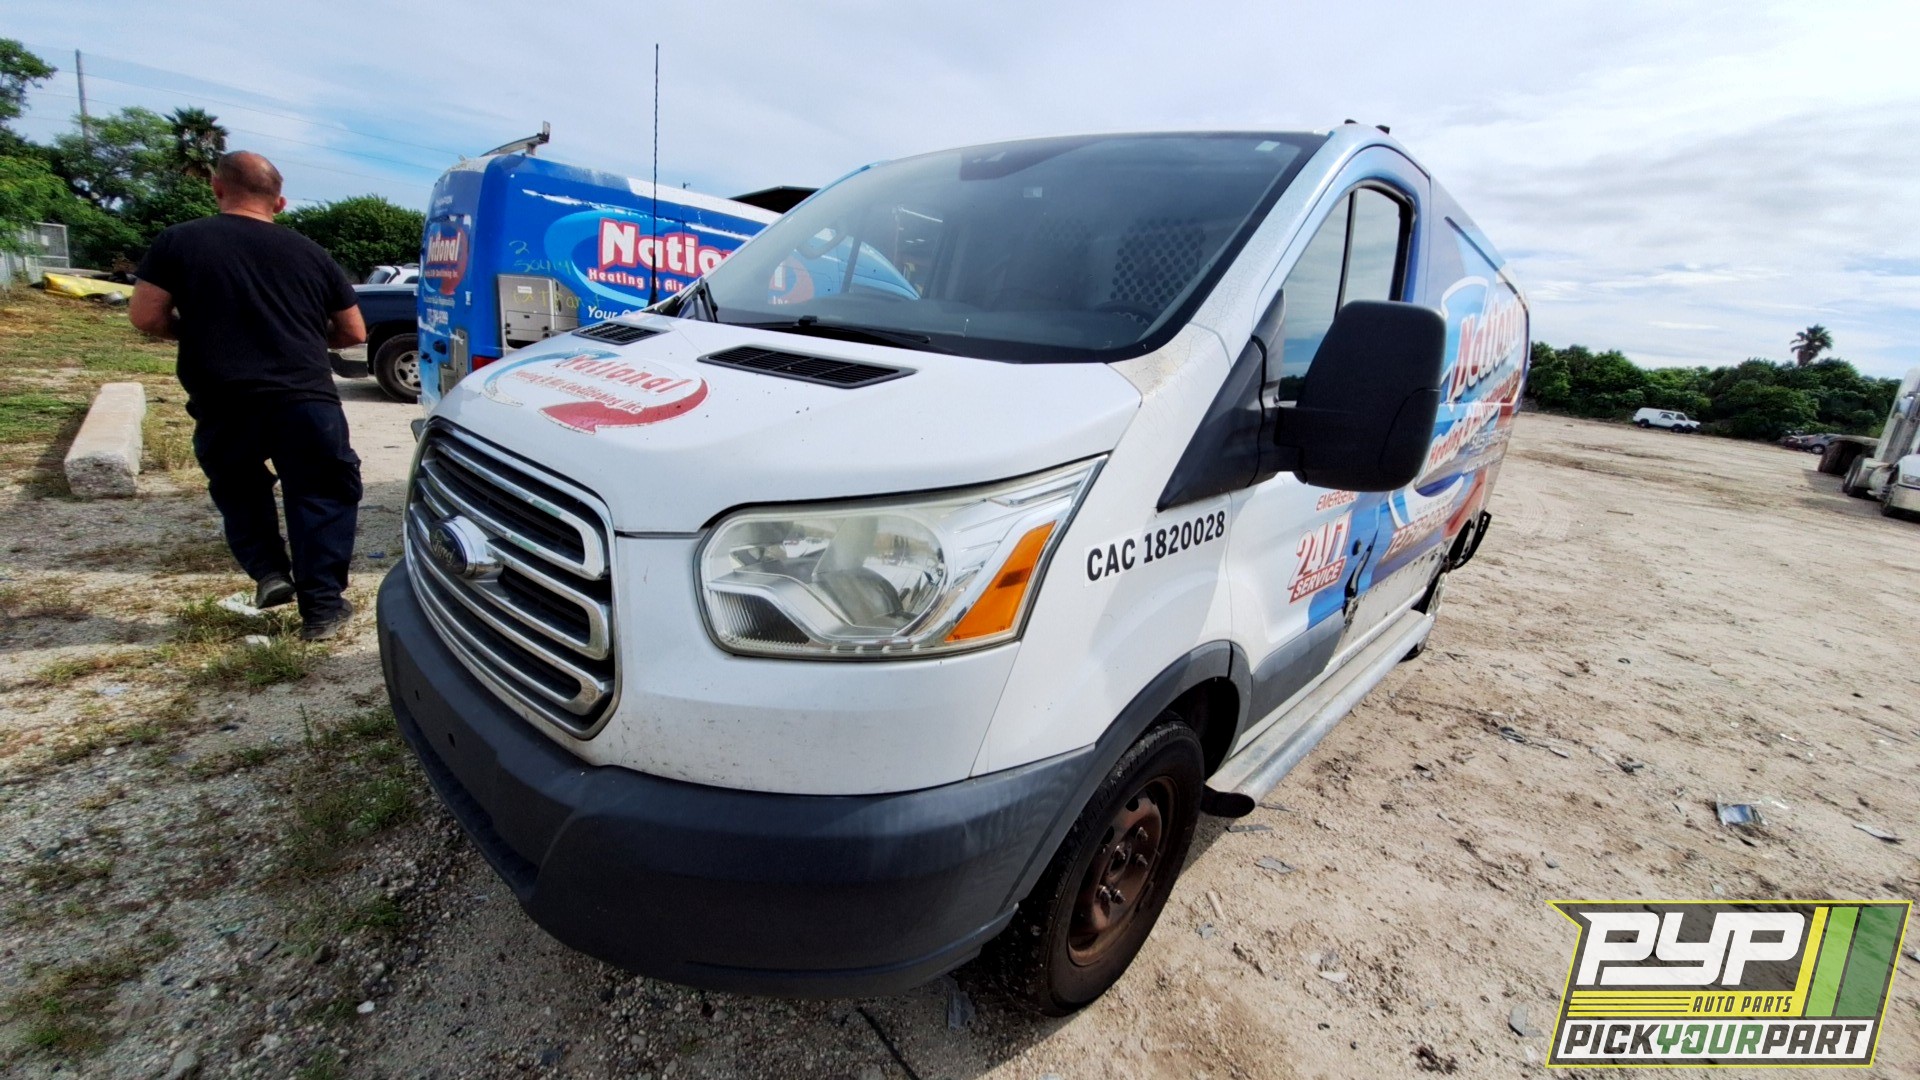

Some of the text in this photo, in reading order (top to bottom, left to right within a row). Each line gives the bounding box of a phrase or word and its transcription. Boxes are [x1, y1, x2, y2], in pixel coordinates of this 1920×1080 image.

[588, 268, 645, 289] Heating
[588, 304, 618, 319] Your
[554, 354, 693, 394] National
[1086, 510, 1226, 582] CAC 1820028
[1292, 563, 1342, 598] SERVICE
